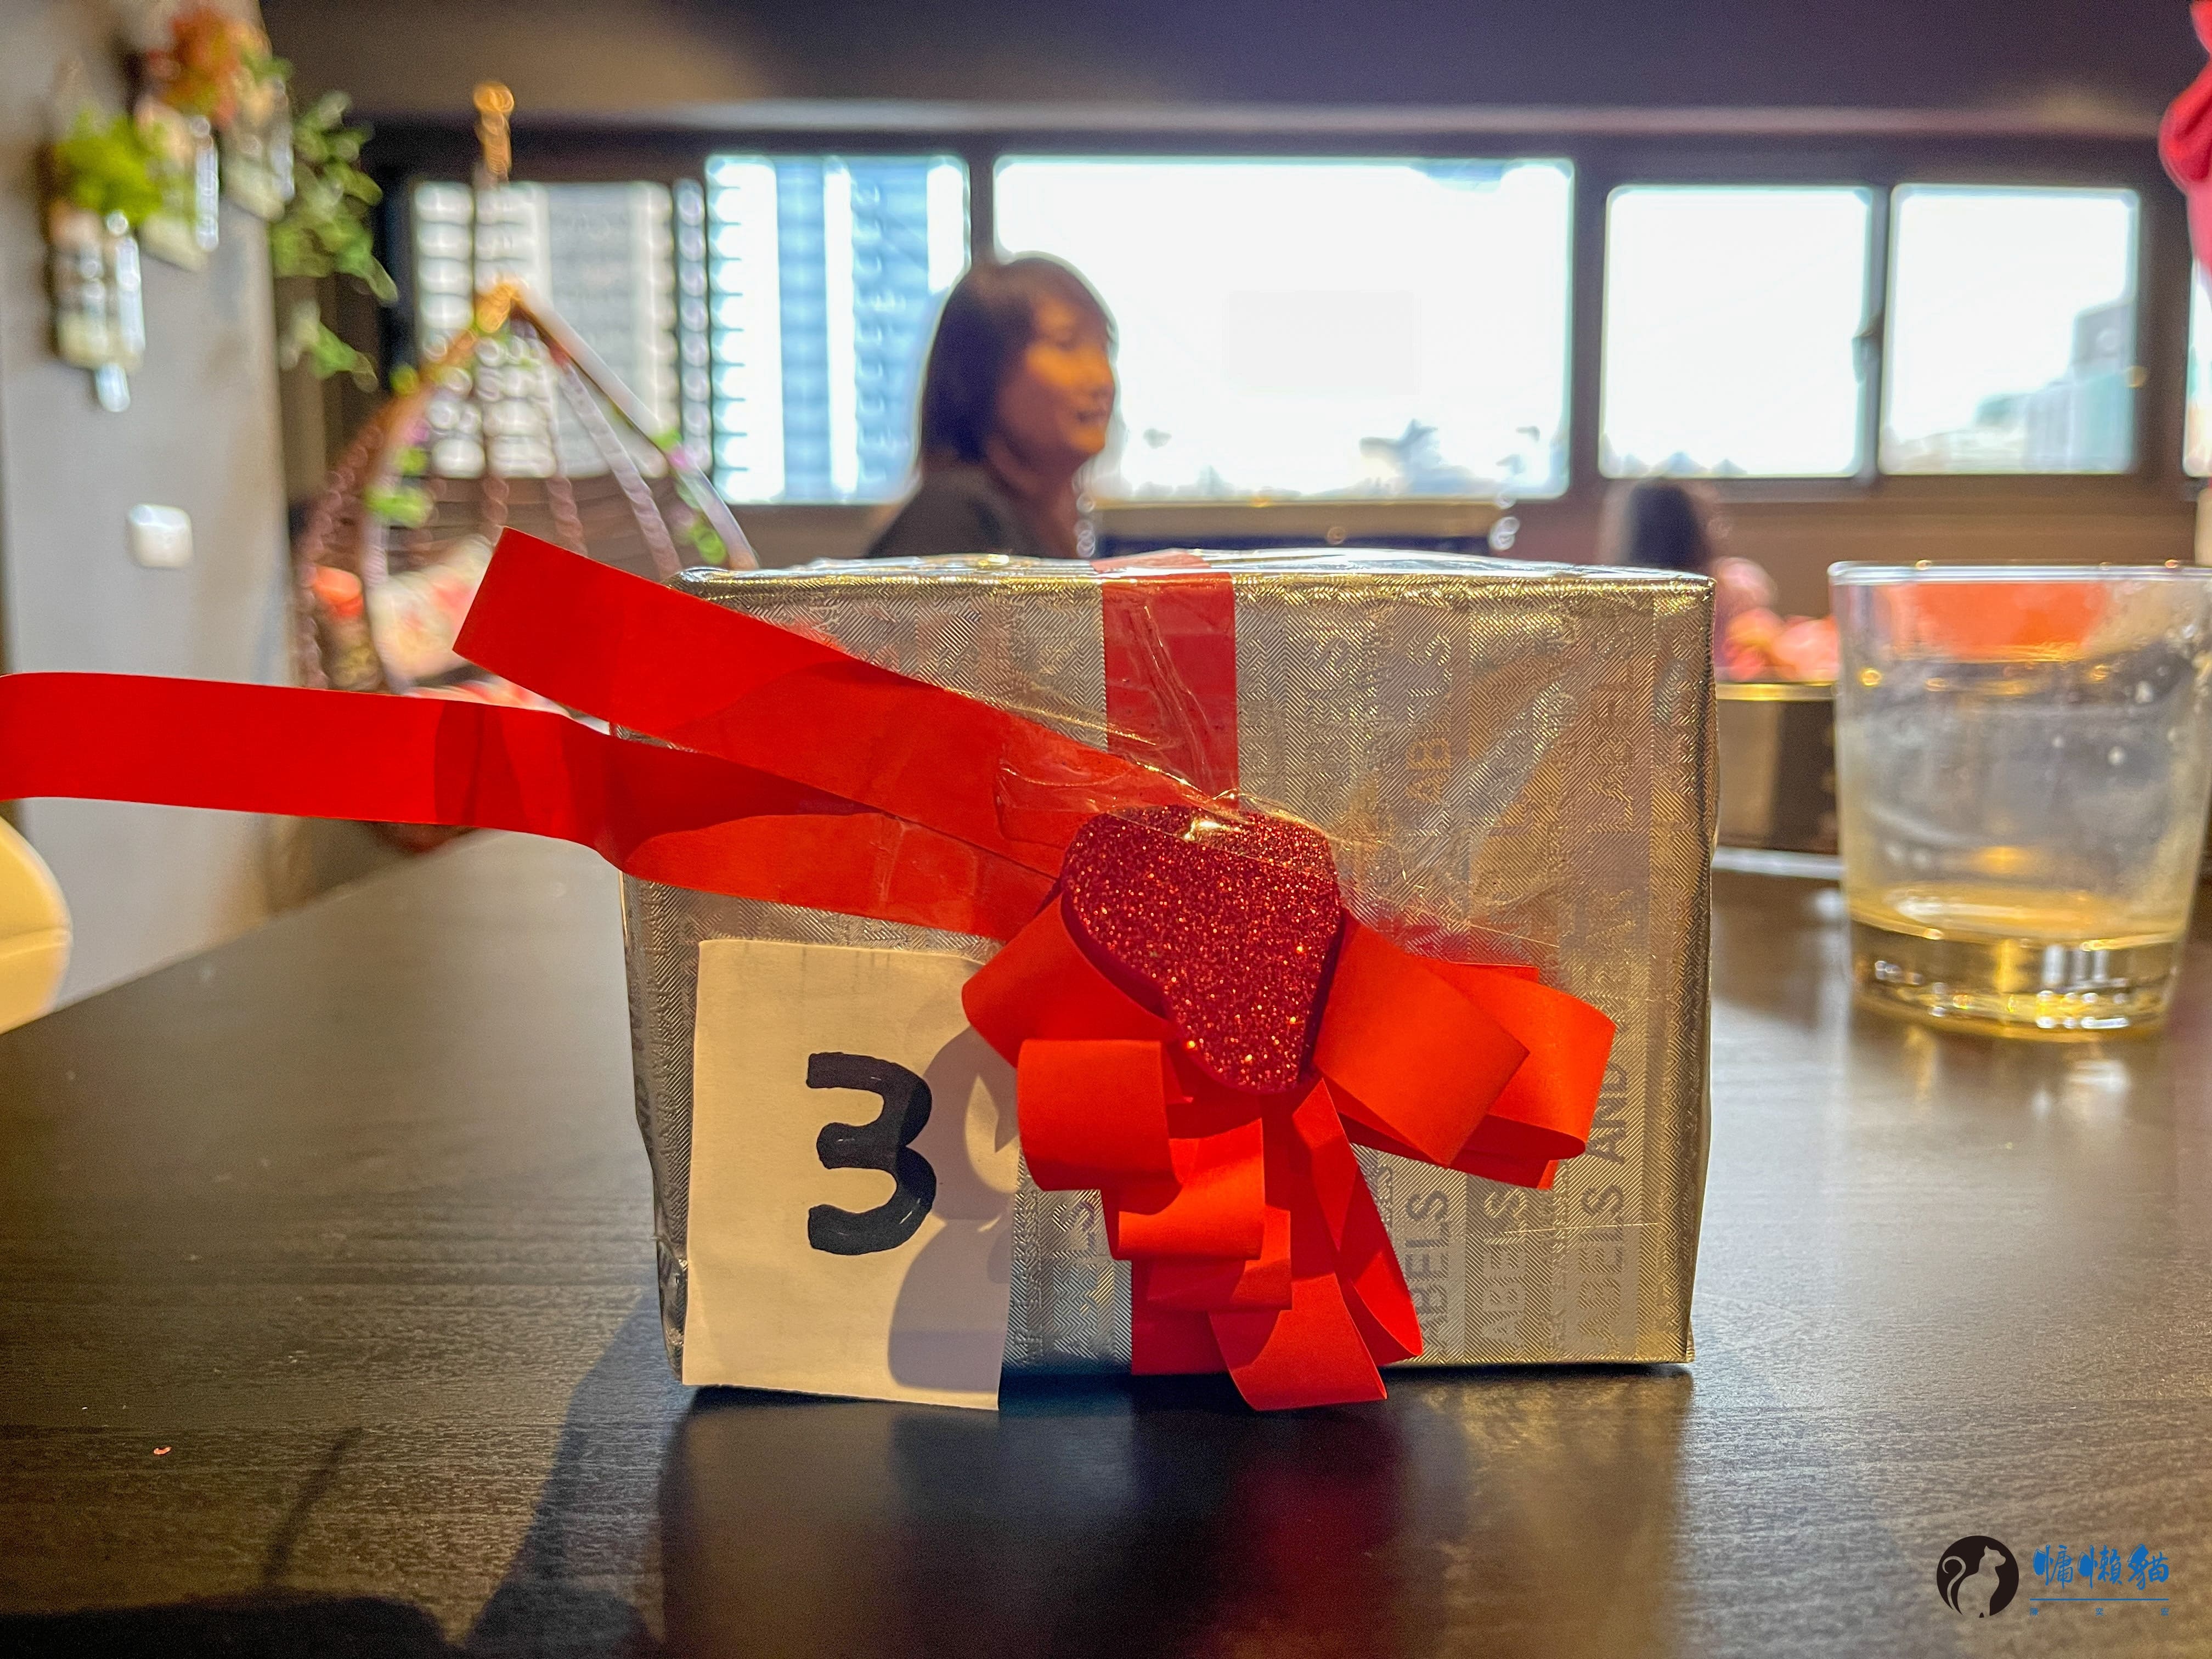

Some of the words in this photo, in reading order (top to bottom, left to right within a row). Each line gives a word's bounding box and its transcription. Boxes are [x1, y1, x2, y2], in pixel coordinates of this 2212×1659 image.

[806, 1052, 937, 1255] 3
[1584, 1063, 1627, 1165] AND
[1052, 1200, 1098, 1359] ABELS
